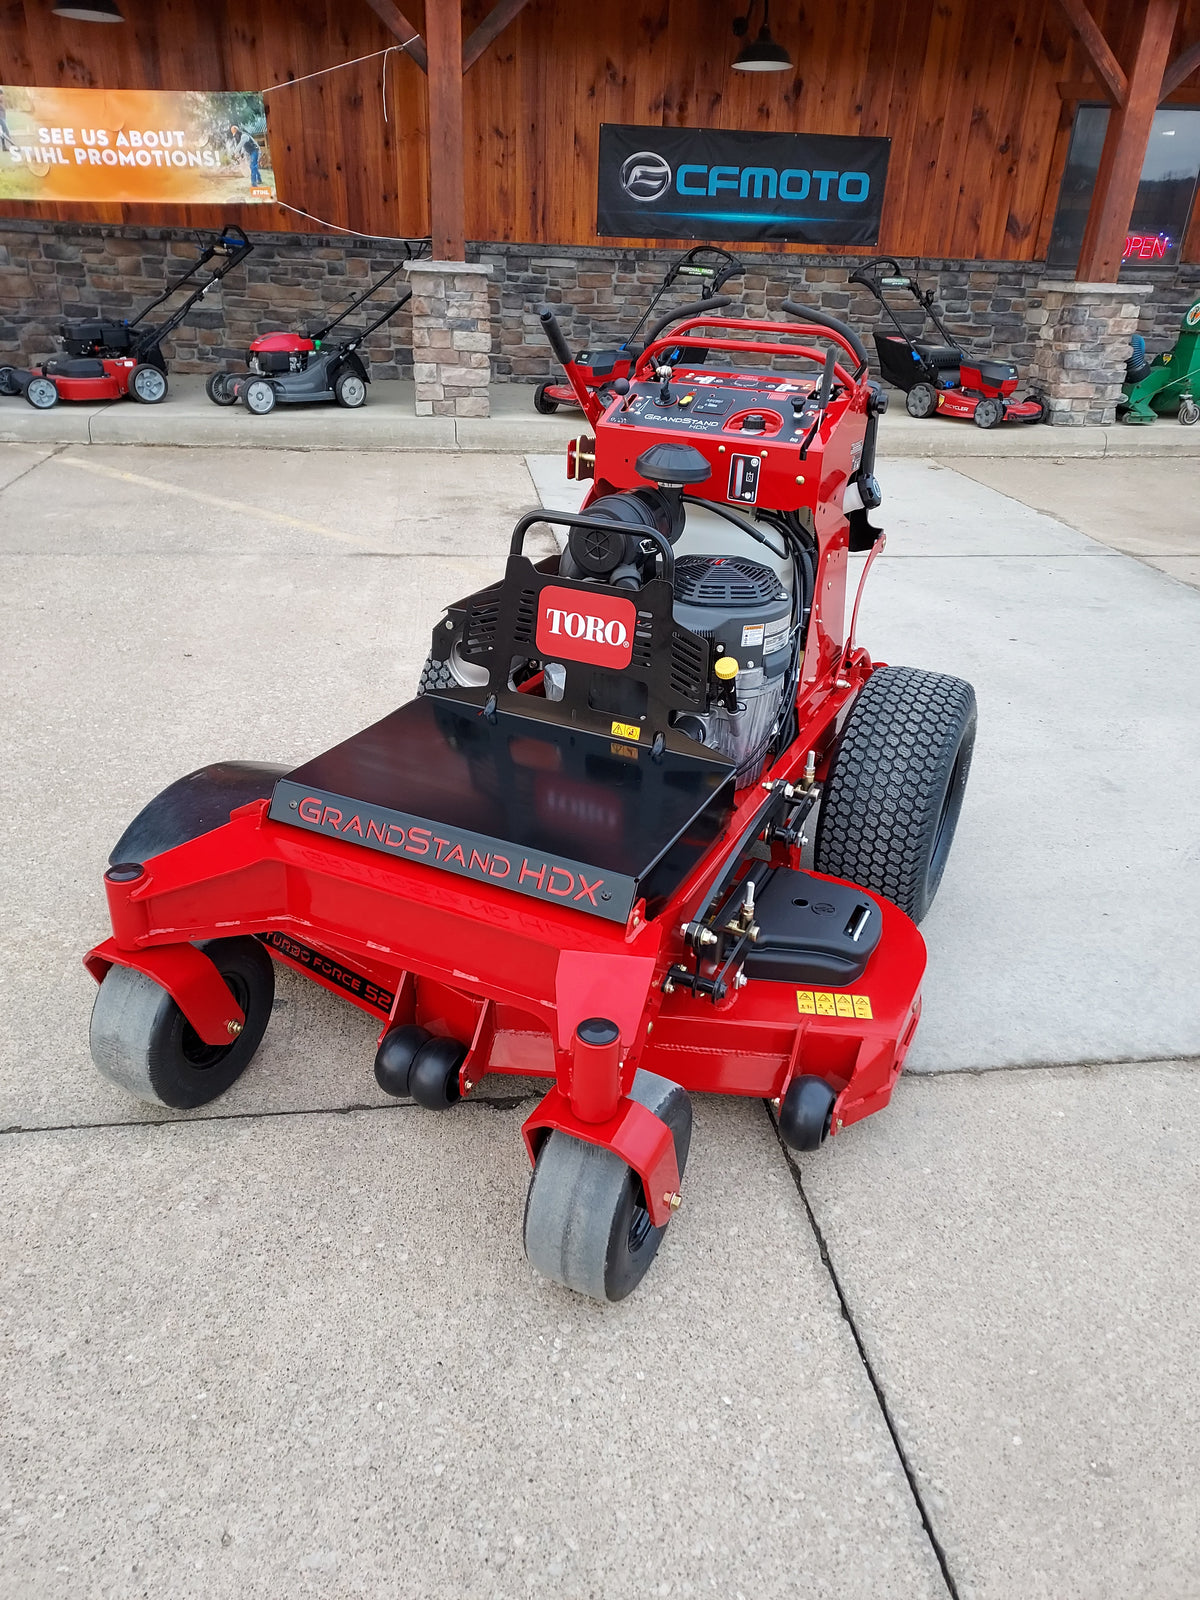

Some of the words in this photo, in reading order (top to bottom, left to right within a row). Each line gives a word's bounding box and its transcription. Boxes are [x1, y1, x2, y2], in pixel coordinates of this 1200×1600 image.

[39, 128, 76, 145] SEE
[83, 130, 109, 146] US
[116, 130, 184, 148] ABOUT
[10, 147, 70, 165] STIHL
[75, 149, 221, 168] PROMOTIONS!
[676, 164, 870, 202] CFMOTO
[518, 858, 605, 907] HDX
[313, 957, 362, 991] FORCE
[364, 984, 392, 1010] 52
